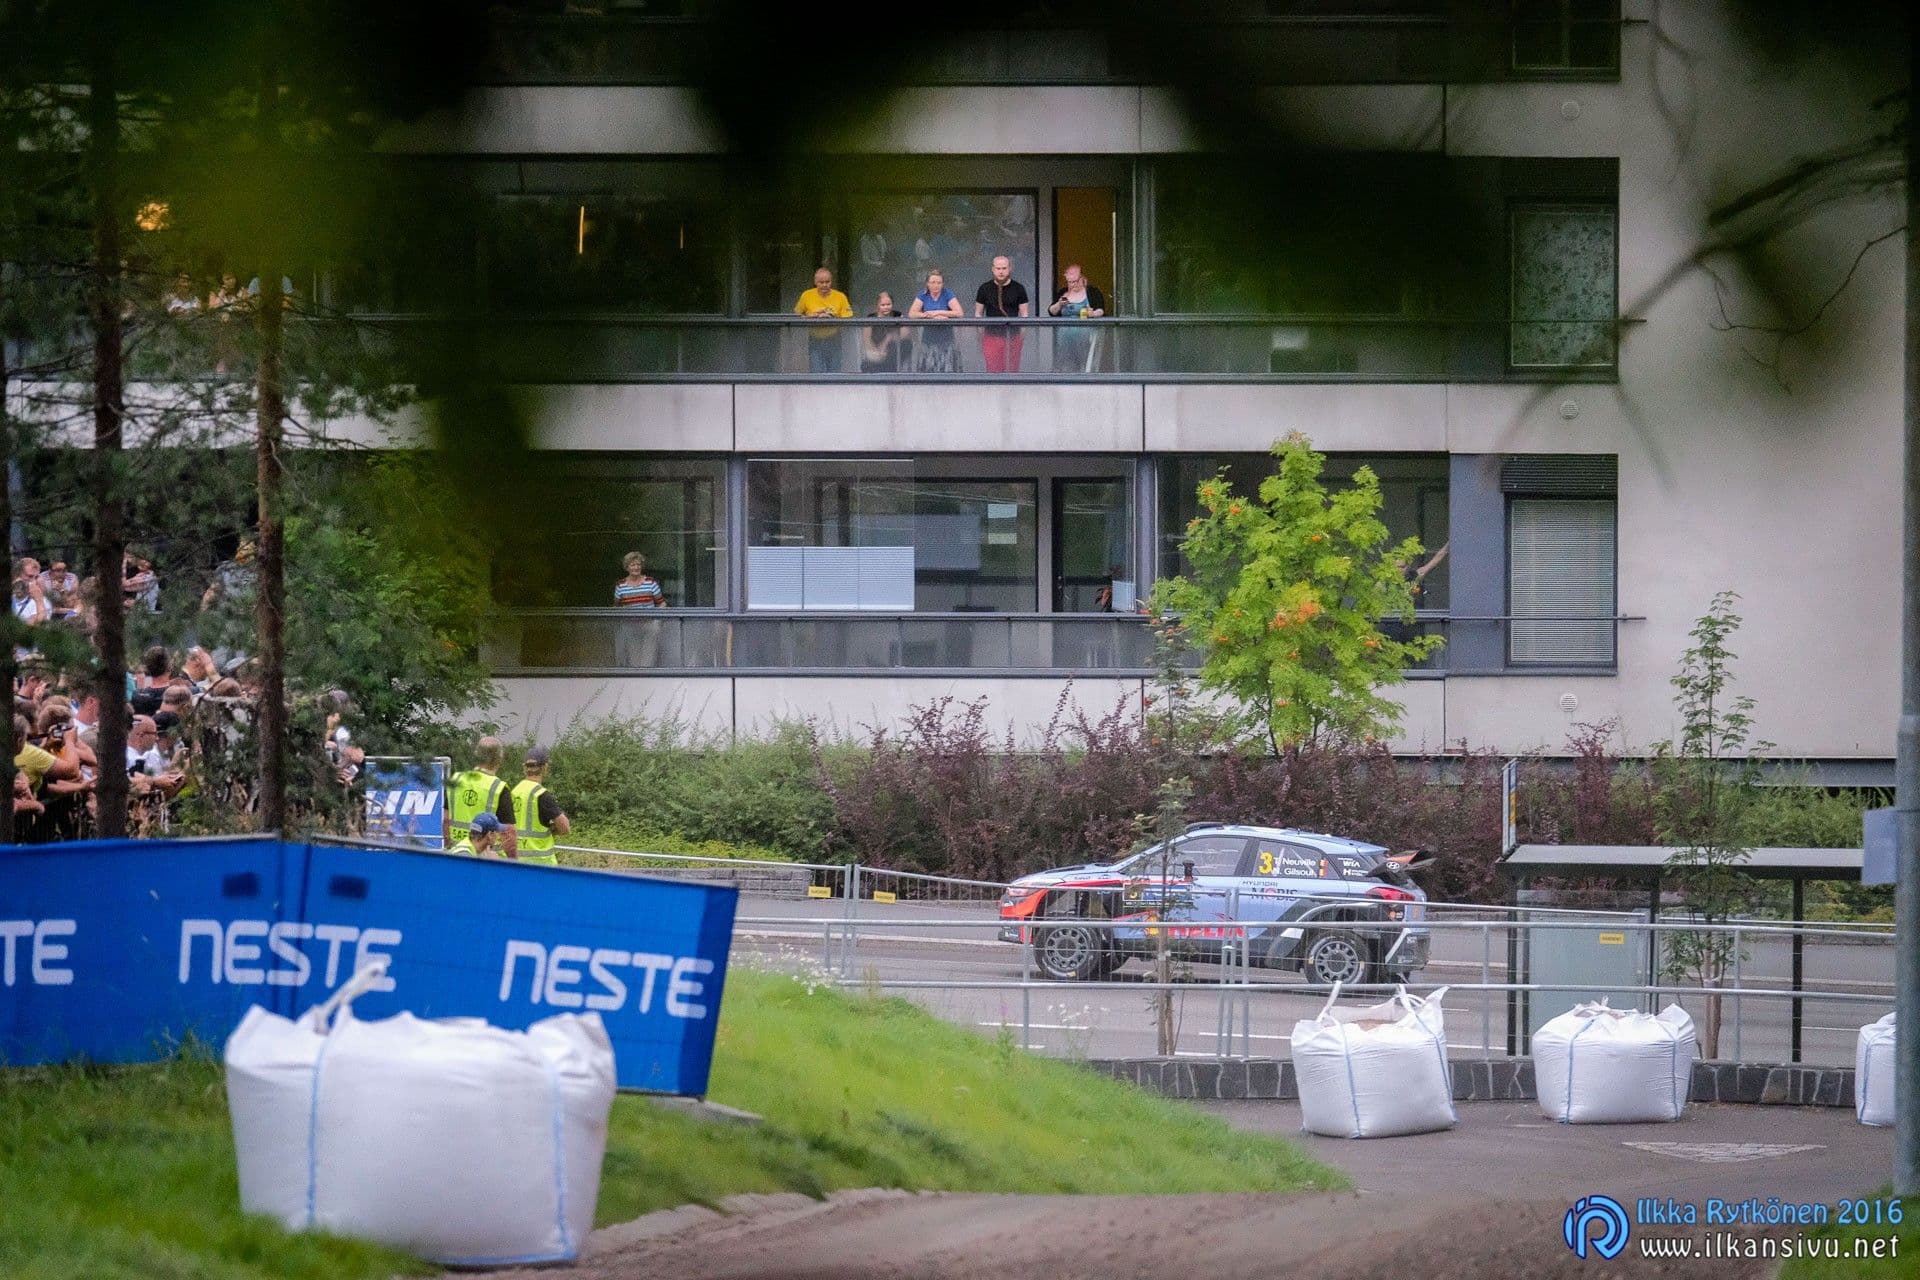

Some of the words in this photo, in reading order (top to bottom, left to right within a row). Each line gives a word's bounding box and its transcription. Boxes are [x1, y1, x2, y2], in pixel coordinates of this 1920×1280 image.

[1258, 851, 1273, 875] 3
[178, 918, 404, 993] NESTE
[498, 938, 715, 1020] NESTE
